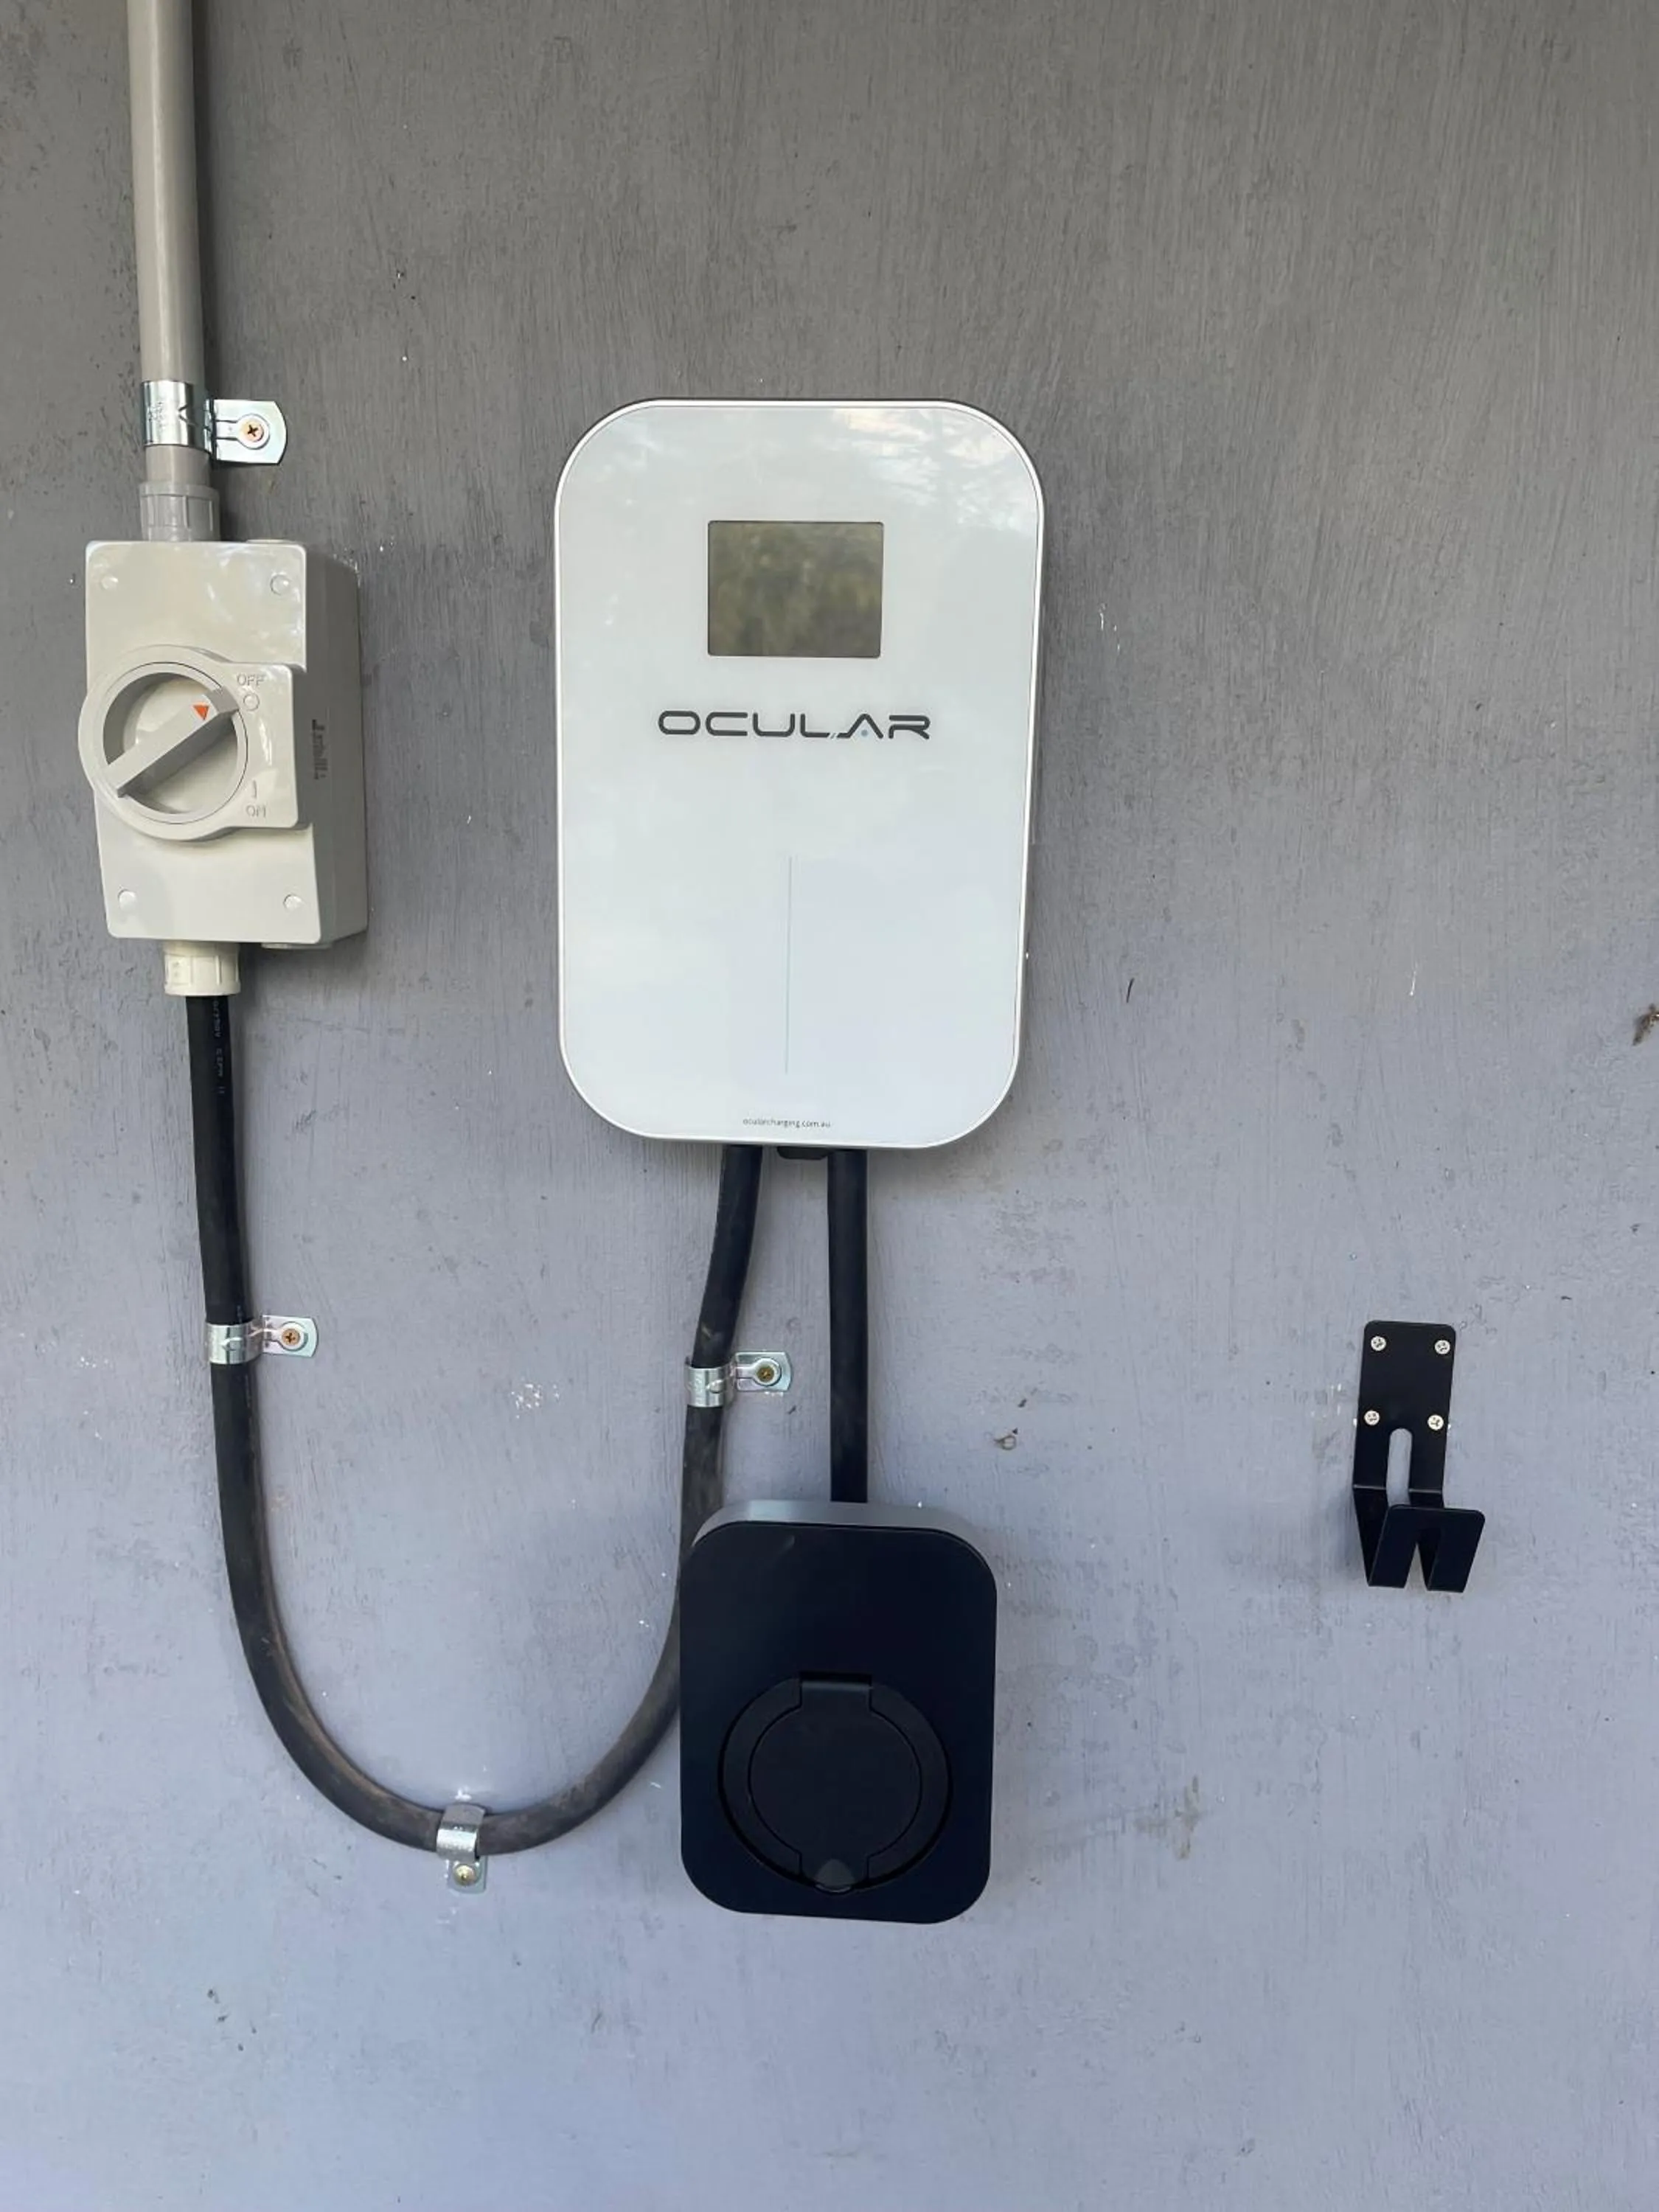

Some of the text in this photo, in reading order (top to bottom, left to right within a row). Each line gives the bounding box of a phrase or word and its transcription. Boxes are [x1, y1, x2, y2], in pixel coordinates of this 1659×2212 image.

[237, 673, 265, 686] OFF
[658, 710, 931, 740] OCULAR
[246, 804, 266, 818] ON
